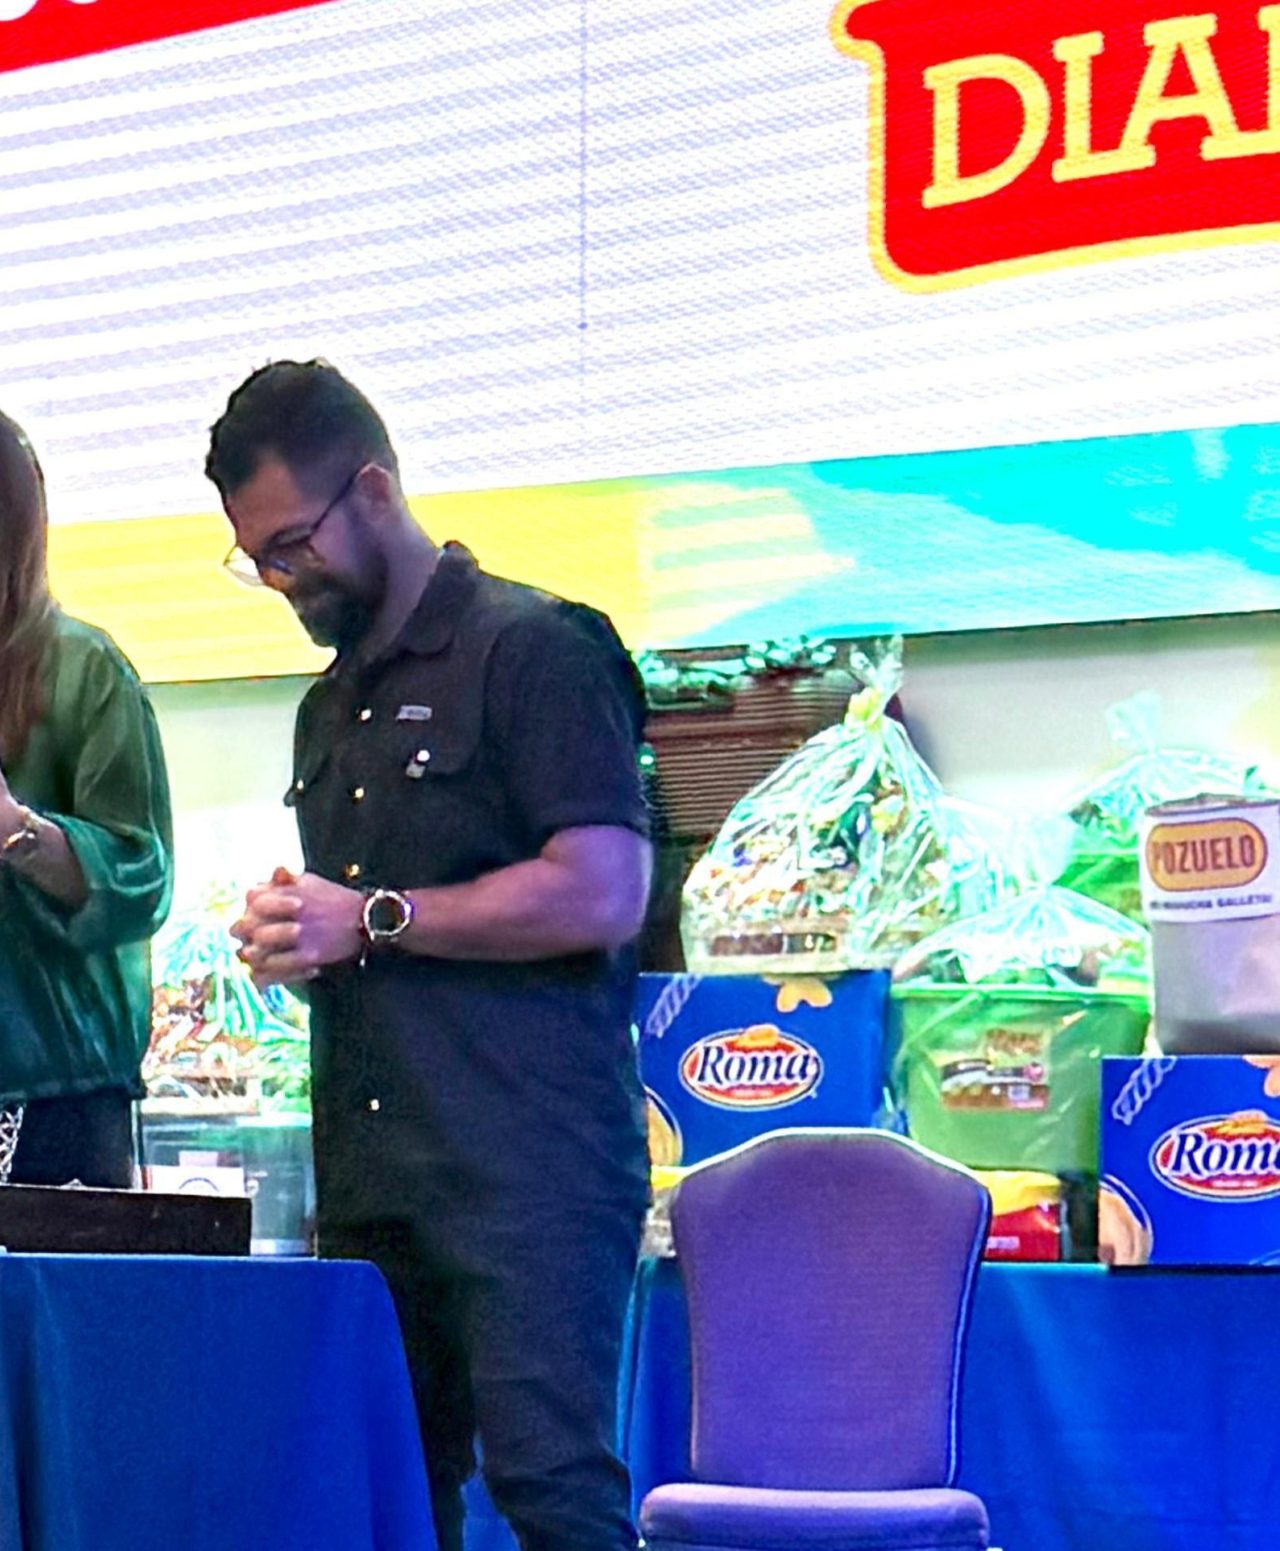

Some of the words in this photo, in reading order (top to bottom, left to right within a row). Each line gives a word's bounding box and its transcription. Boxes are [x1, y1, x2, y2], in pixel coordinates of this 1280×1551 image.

[1152, 834, 1255, 875] POZUELO
[697, 1045, 812, 1085] Roma
[1171, 1132, 1280, 1176] Rom
